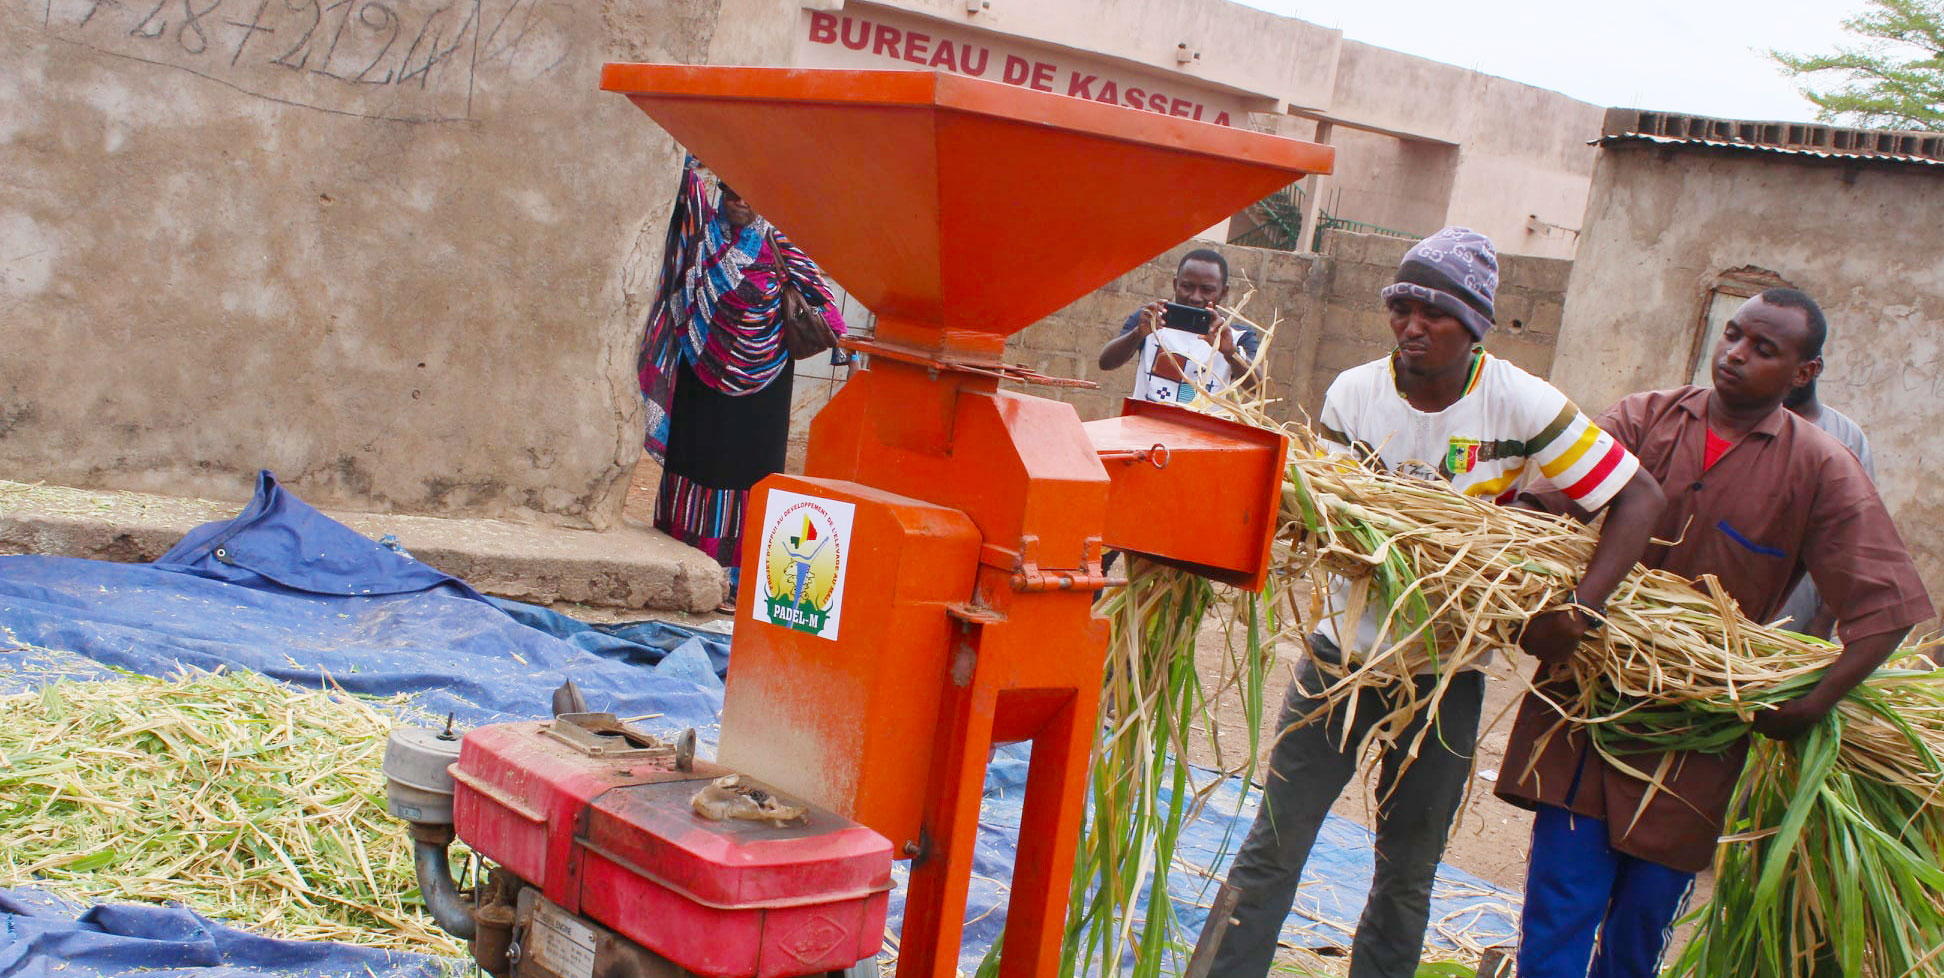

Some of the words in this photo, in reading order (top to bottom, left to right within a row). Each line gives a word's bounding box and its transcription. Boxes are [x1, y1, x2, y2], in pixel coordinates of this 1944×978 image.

[808, 11, 990, 77] BUREAU
[1002, 55, 1057, 93] DE
[777, 515, 784, 526] AU
[784, 502, 828, 517] DEVELOPPEMENT
[774, 604, 819, 628] PADEL-M
